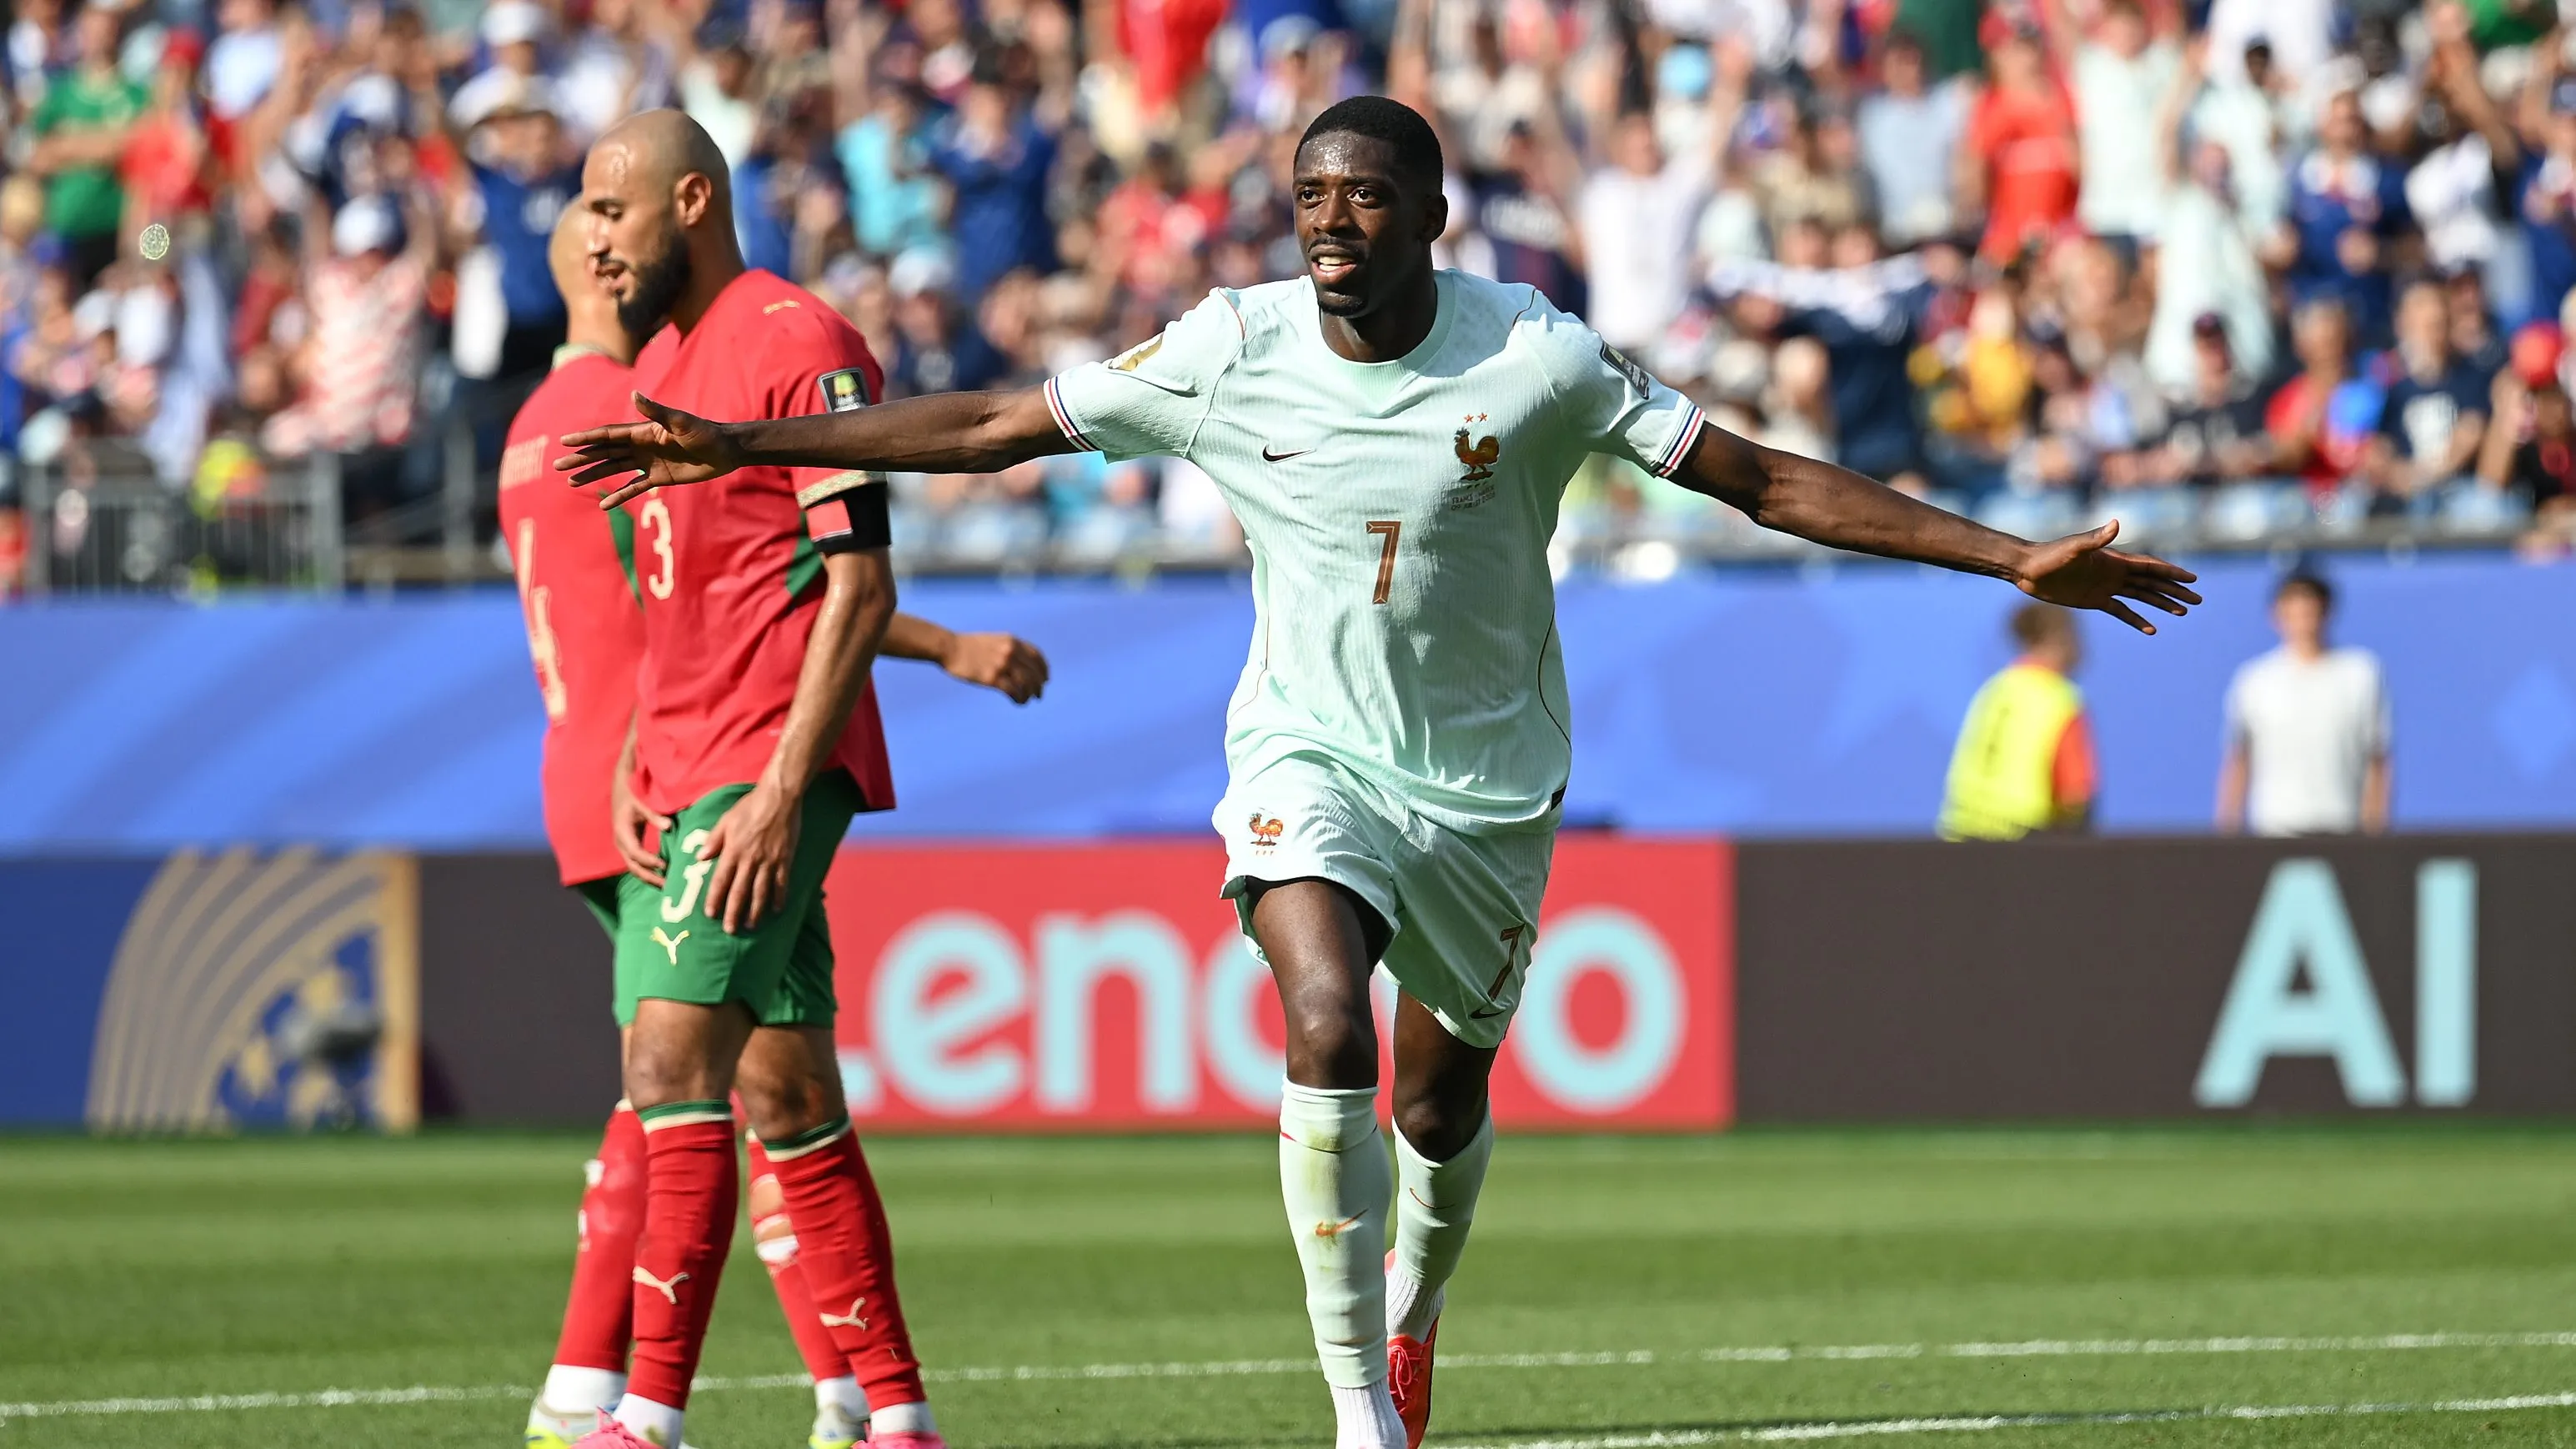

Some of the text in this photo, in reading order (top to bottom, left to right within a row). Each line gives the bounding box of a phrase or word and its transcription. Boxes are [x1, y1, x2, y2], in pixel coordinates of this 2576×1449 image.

[640, 497, 674, 600] 3
[1366, 520, 1401, 604] 7
[660, 828, 714, 924] 3
[1486, 923, 1526, 1001] 7
[2193, 856, 2478, 1108] AI
